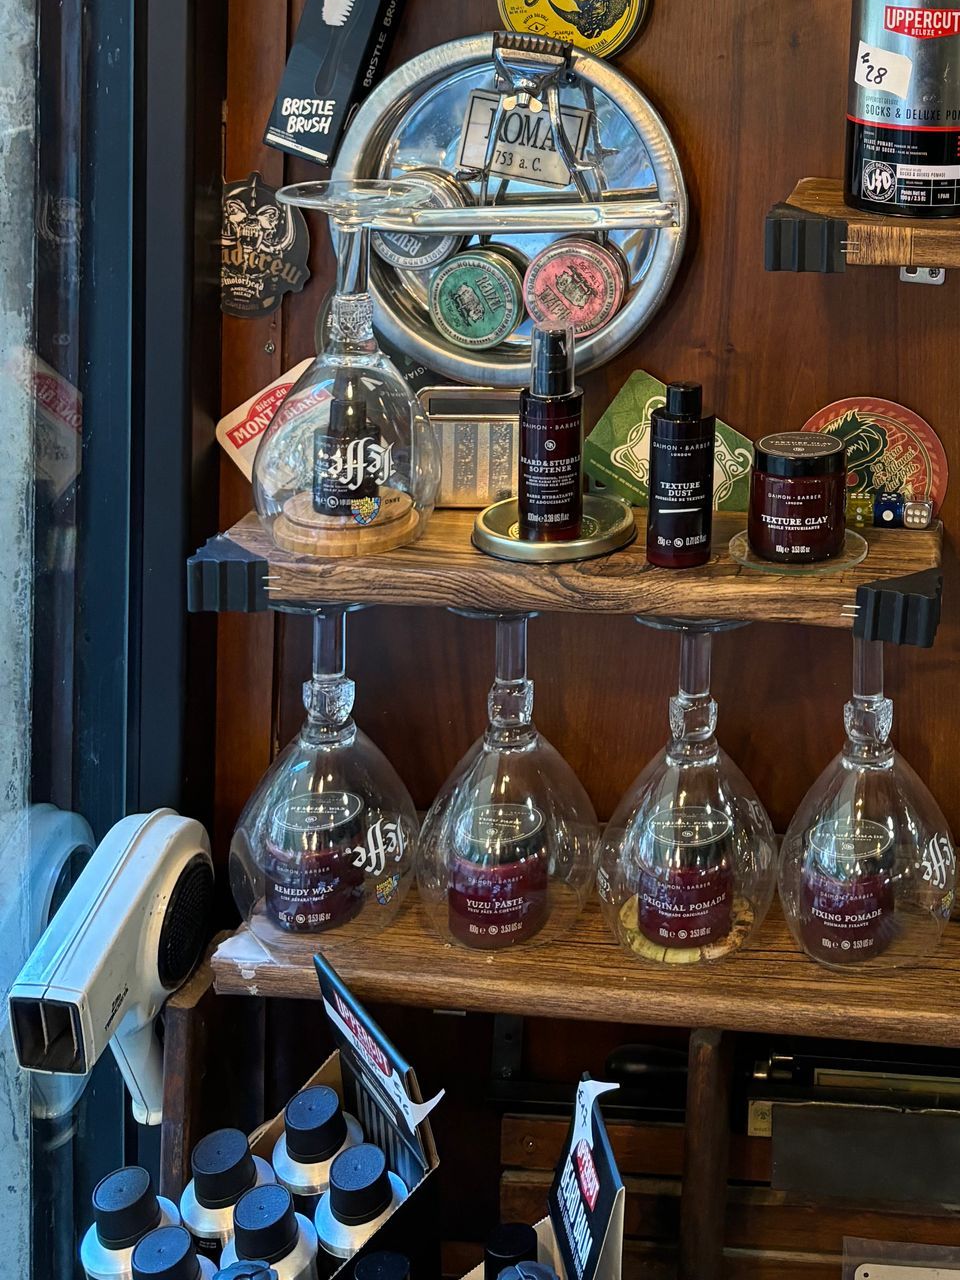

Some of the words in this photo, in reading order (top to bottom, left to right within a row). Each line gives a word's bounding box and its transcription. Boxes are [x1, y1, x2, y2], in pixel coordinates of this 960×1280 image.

[886, 8, 960, 32] UPPERCUT
[911, 28, 935, 36] DELUXE
[363, 31, 386, 88] BRISTLE
[866, 65, 888, 84] 28
[282, 98, 336, 116] BRISTLE
[865, 104, 891, 118] SOCKS
[895, 109, 901, 118] &
[906, 109, 940, 120] DELUXE
[287, 116, 332, 135] BRUSH
[495, 150, 514, 166] 753
[532, 157, 542, 172] C.
[255, 396, 276, 412] Bière
[276, 388, 287, 400] du
[232, 406, 274, 444] MONT
[523, 422, 547, 431] DAIMON
[653, 442, 678, 451] DAIMON
[521, 456, 542, 466] BEARD
[549, 455, 581, 466] STUBBLE
[529, 465, 572, 474] SOFTENER
[660, 481, 701, 490] TEXTURE
[768, 492, 792, 500] DAIMON
[761, 515, 802, 525] TEXTURE
[805, 515, 828, 525] CLAY
[274, 884, 309, 896] REMEDY
[312, 885, 334, 895] WAX
[465, 897, 492, 910] YUZU
[494, 896, 524, 910] PASTE
[642, 893, 687, 913] ORIGINAL
[688, 892, 727, 913] POMADE
[810, 907, 843, 922] FIXING
[844, 907, 884, 923] POMADE
